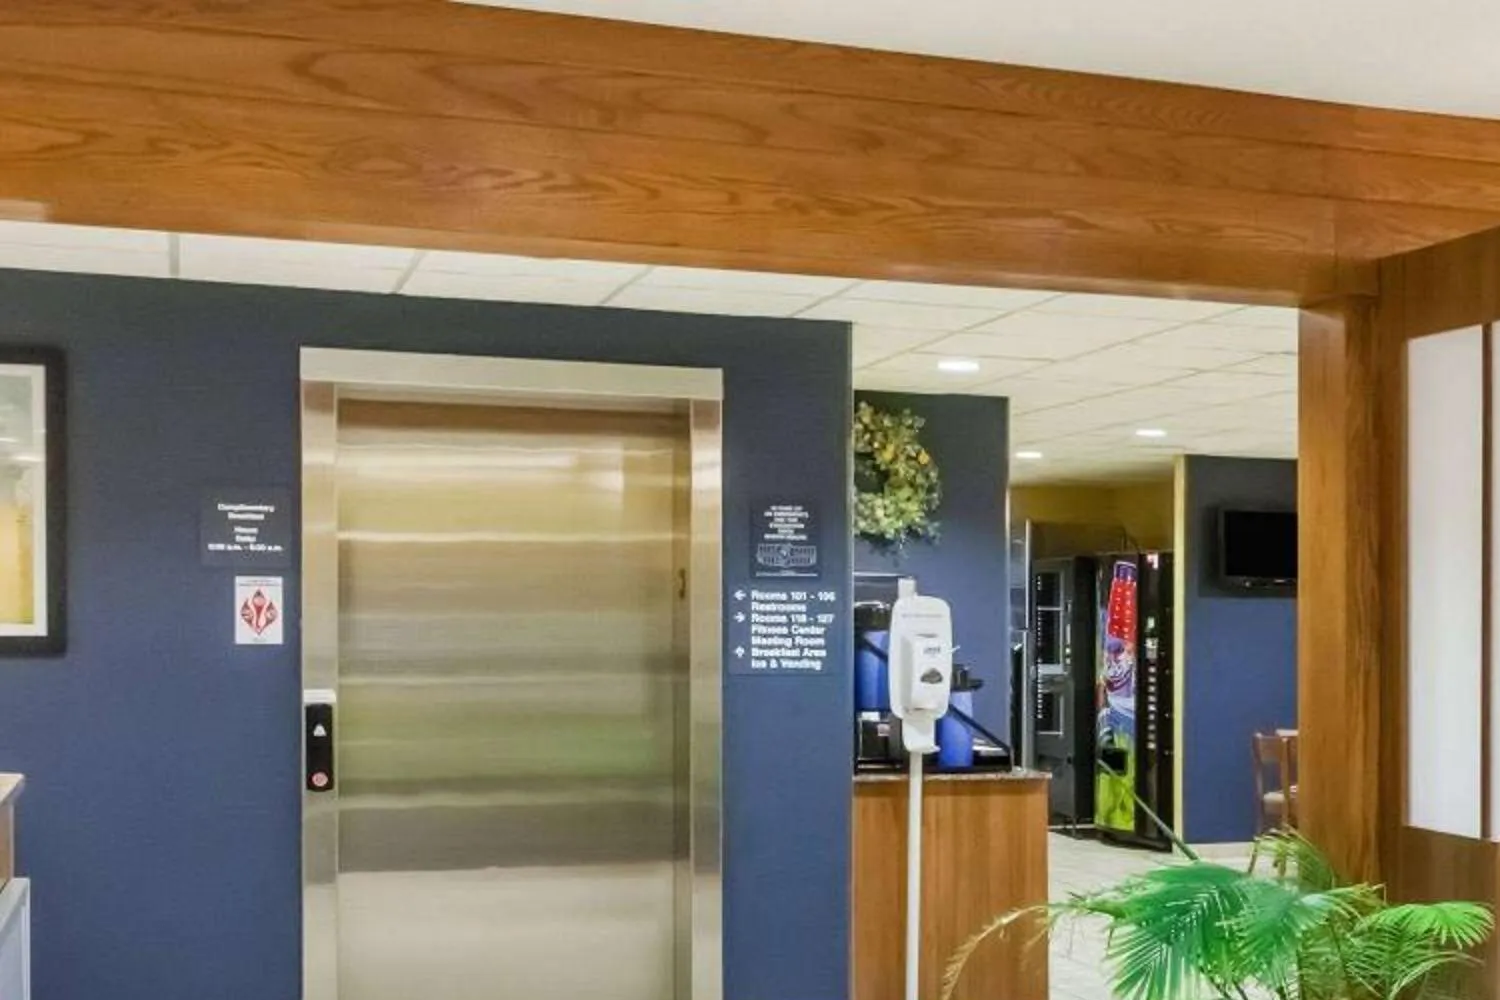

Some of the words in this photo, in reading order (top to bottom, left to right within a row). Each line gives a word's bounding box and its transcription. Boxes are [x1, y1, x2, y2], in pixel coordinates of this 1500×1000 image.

[751, 590, 788, 601] Rooms
[751, 601, 807, 612] Restrooms
[751, 613, 788, 623] Rooms
[791, 624, 826, 635] Center
[794, 635, 825, 647] Room
[751, 647, 801, 657] Breakfast
[802, 647, 827, 657] Area
[751, 658, 767, 669] Ice
[779, 658, 822, 671] Vending
